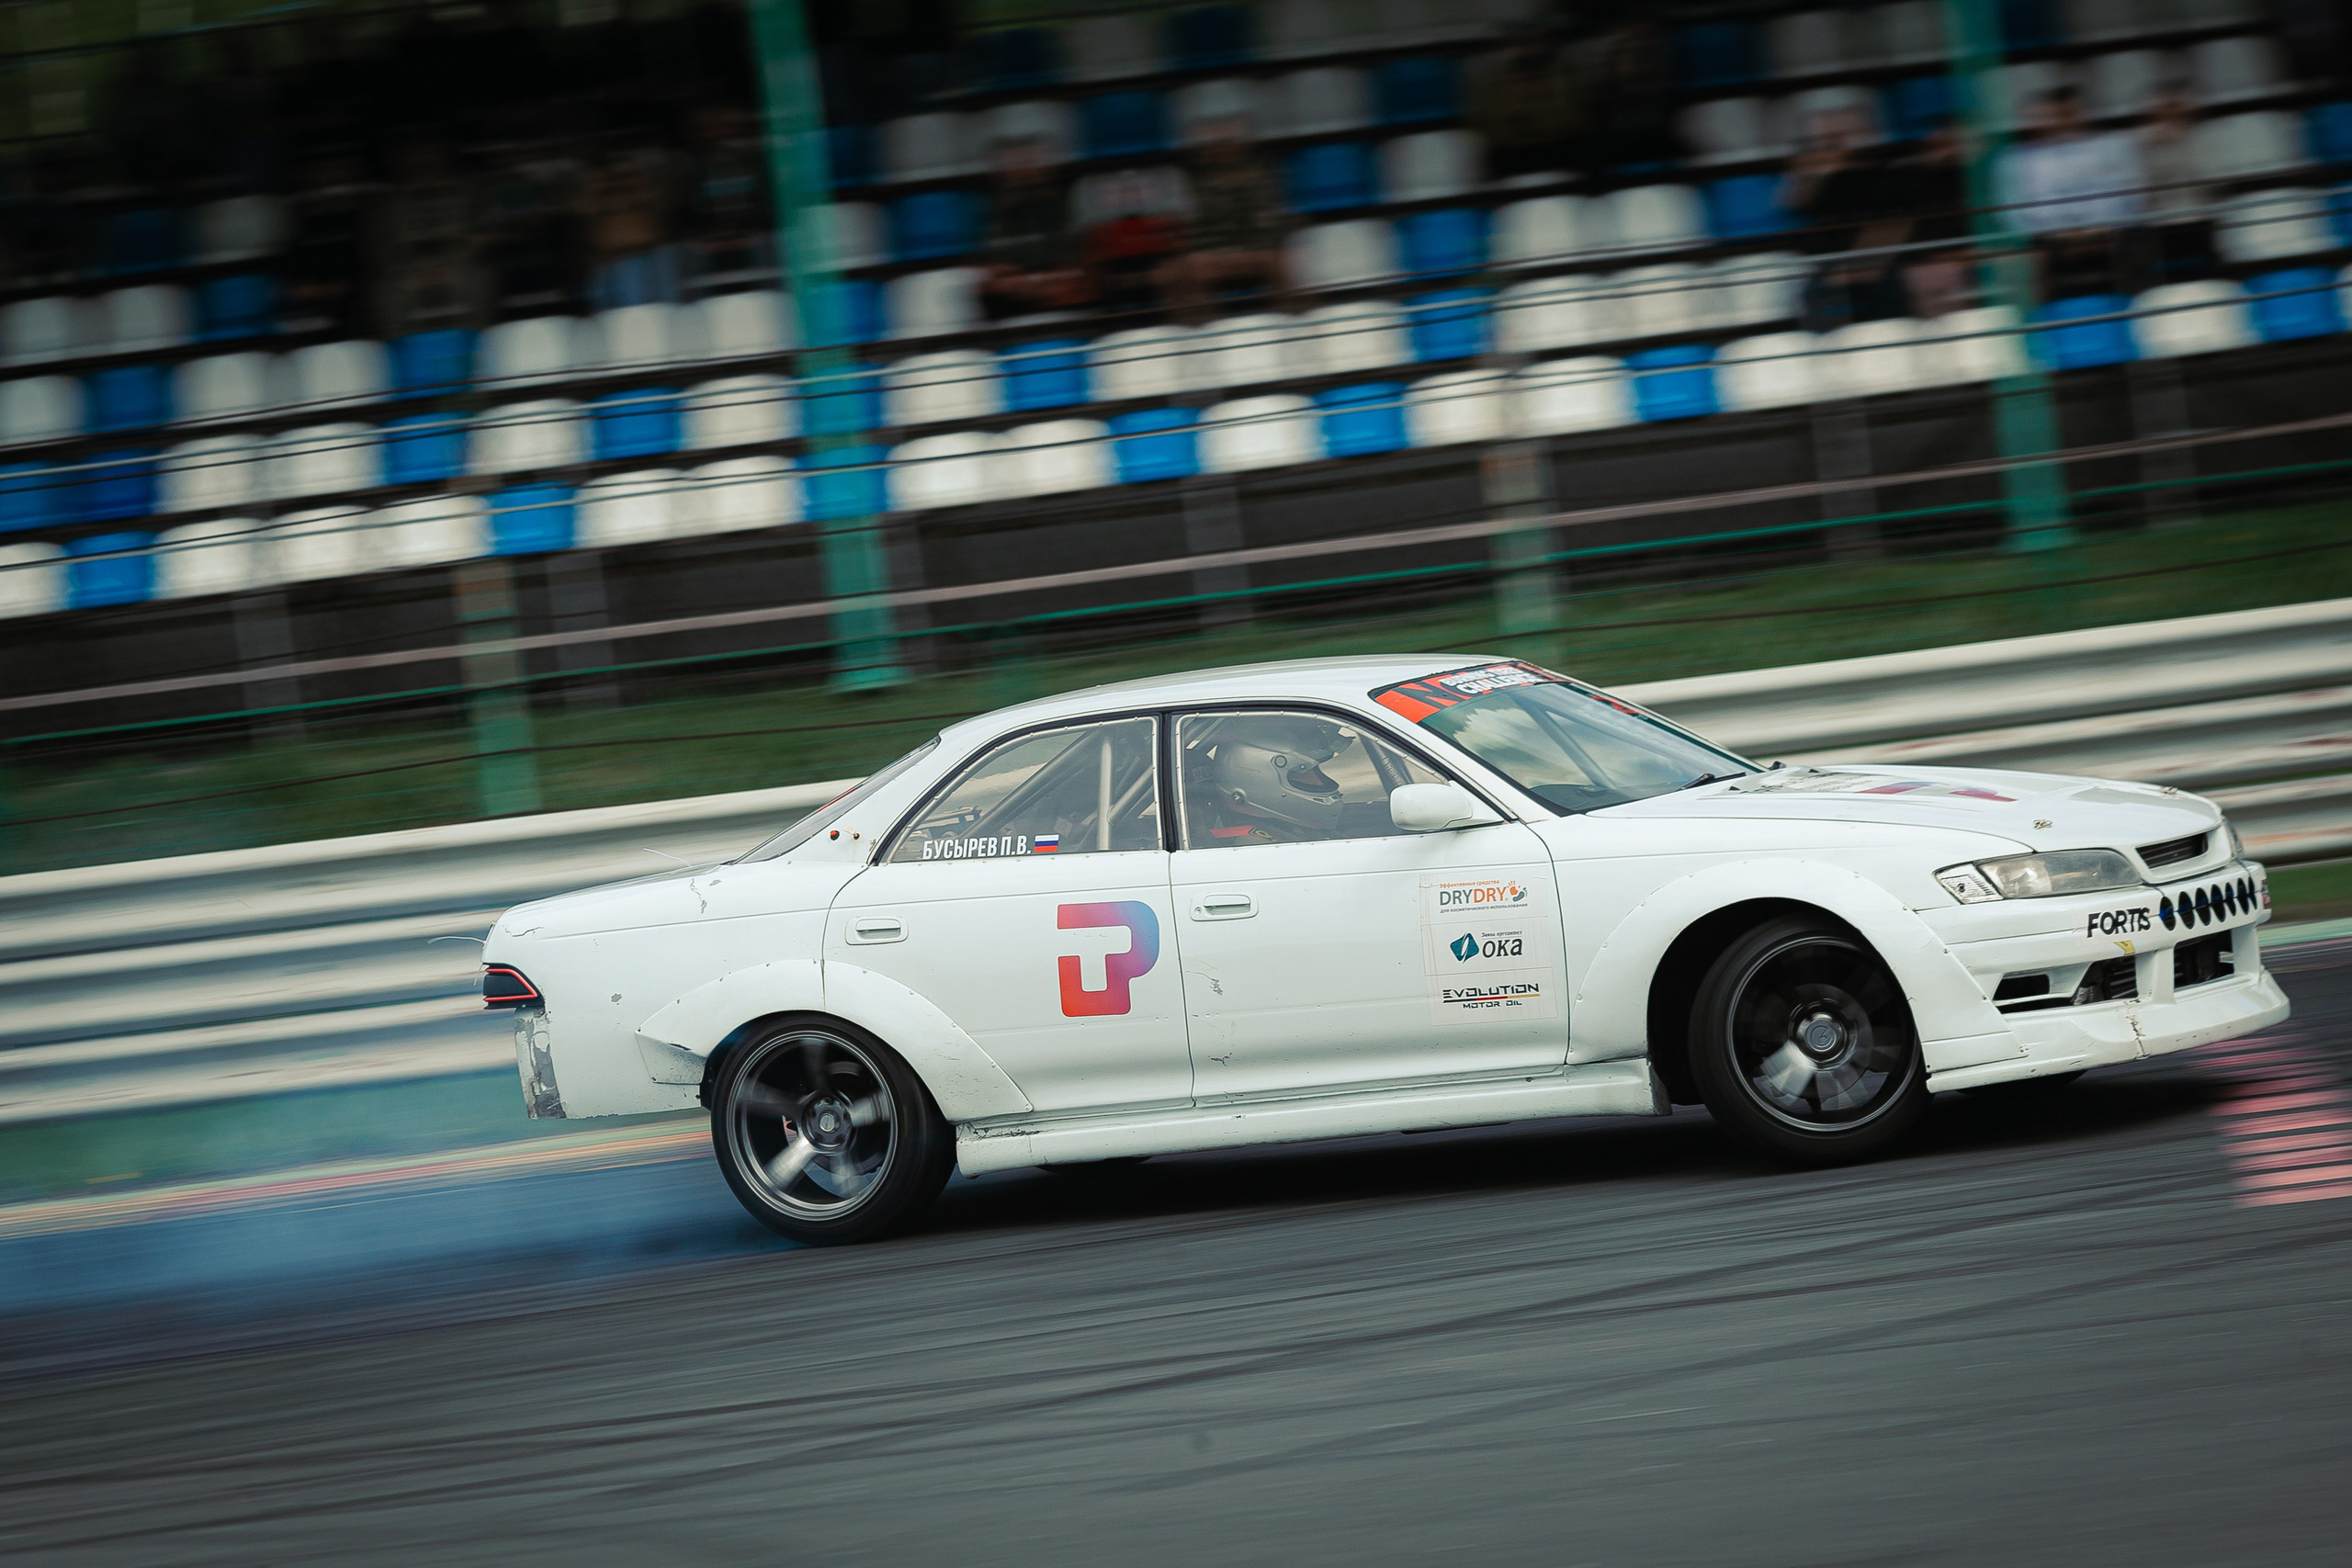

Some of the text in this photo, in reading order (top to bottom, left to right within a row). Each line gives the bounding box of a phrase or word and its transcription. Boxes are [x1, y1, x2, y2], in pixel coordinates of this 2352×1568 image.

[922, 835, 1032, 860] БУСЫРЕВ П.В.
[2086, 907, 2151, 938] FORTIS
[1442, 983, 1539, 998] EVOLUTION
[1463, 1000, 1501, 1009] MOTOR
